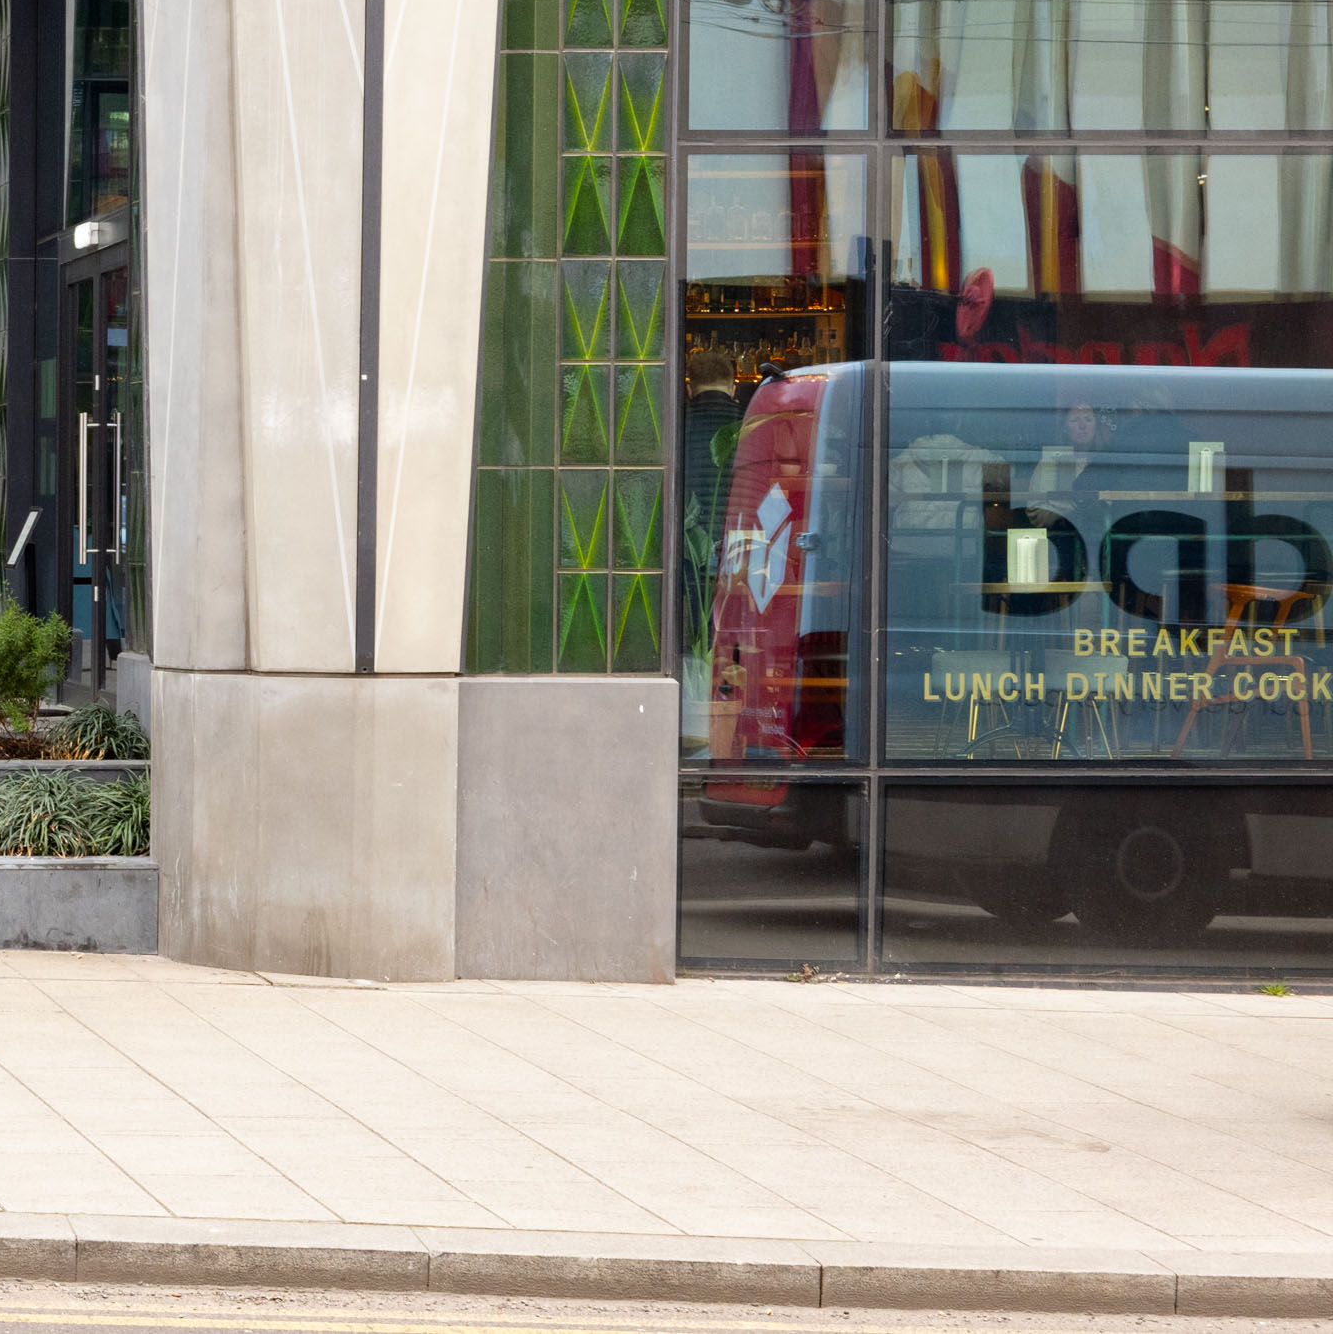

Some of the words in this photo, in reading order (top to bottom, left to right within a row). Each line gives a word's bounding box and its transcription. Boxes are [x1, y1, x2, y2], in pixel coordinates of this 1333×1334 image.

[1074, 628, 1299, 657] BREAKFAST
[924, 672, 1045, 701] LUNCH
[1066, 672, 1213, 702] DINNER
